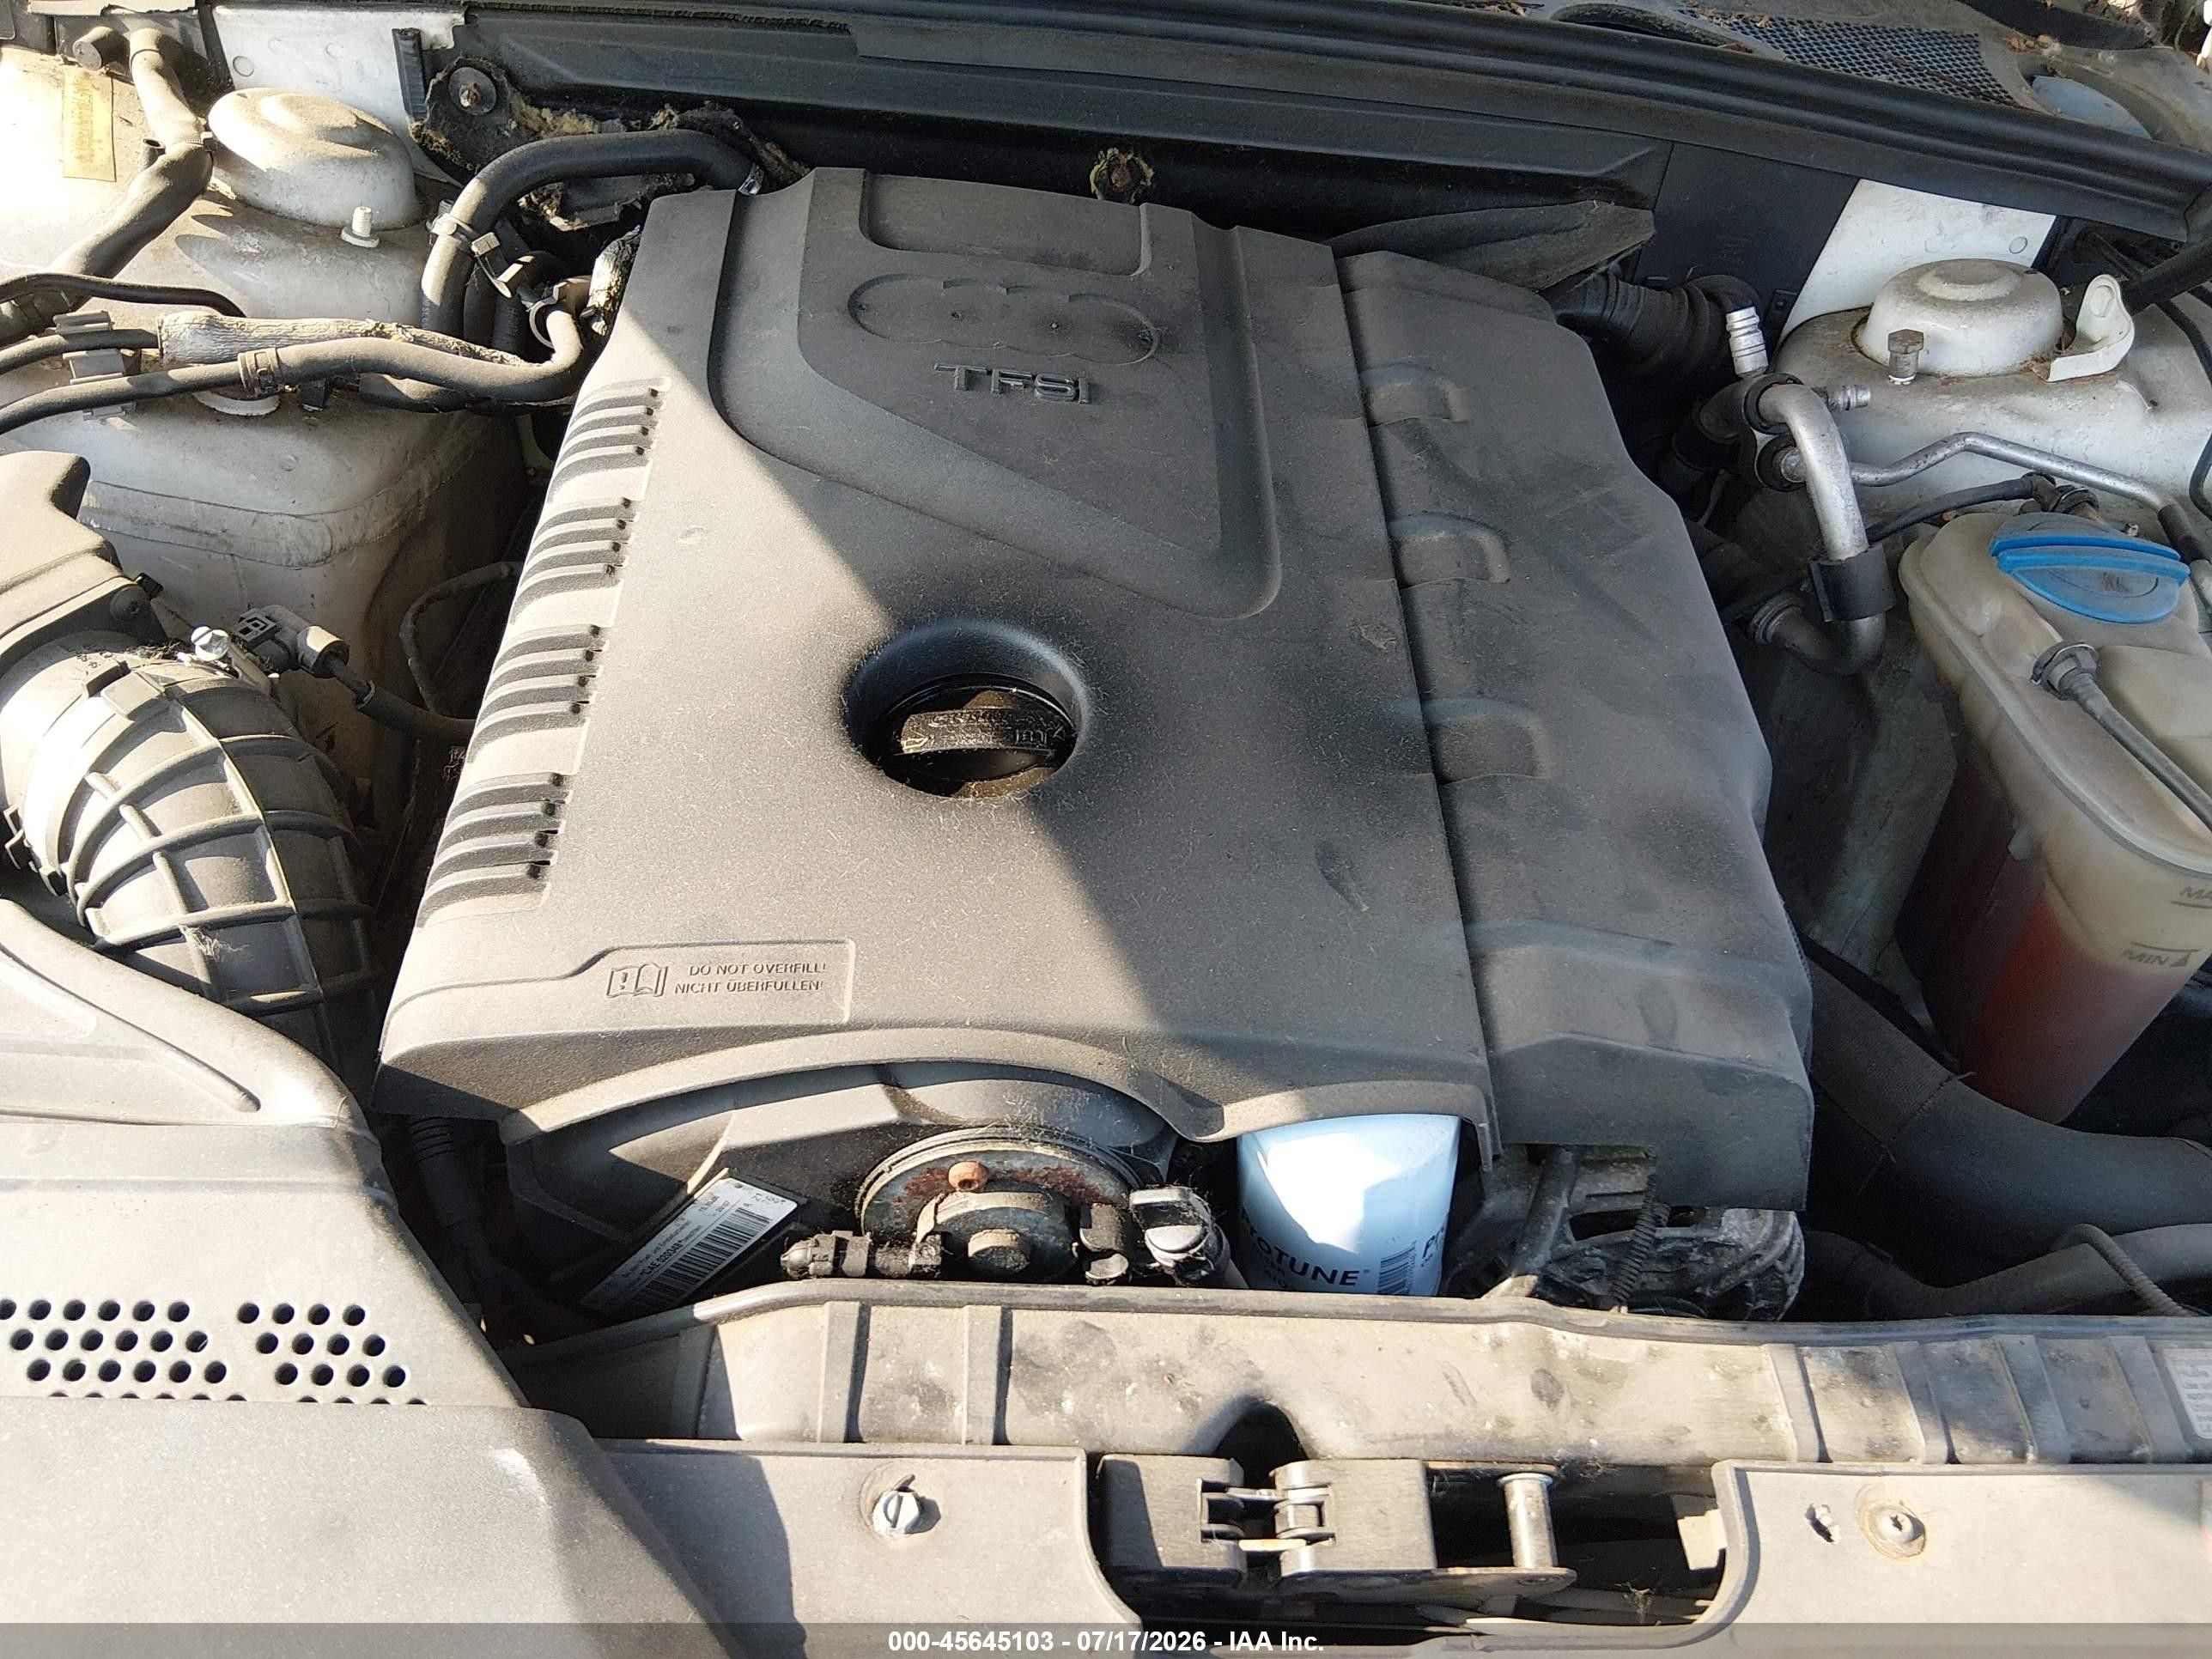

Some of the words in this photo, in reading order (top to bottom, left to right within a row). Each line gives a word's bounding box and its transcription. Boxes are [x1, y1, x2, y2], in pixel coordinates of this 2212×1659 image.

[934, 363, 1090, 404] TFSI
[2120, 949, 2170, 966] MIN
[690, 965, 711, 976] DO
[716, 963, 749, 975] NOT
[753, 963, 826, 974] OVERFILL!
[675, 981, 721, 994] NICHT
